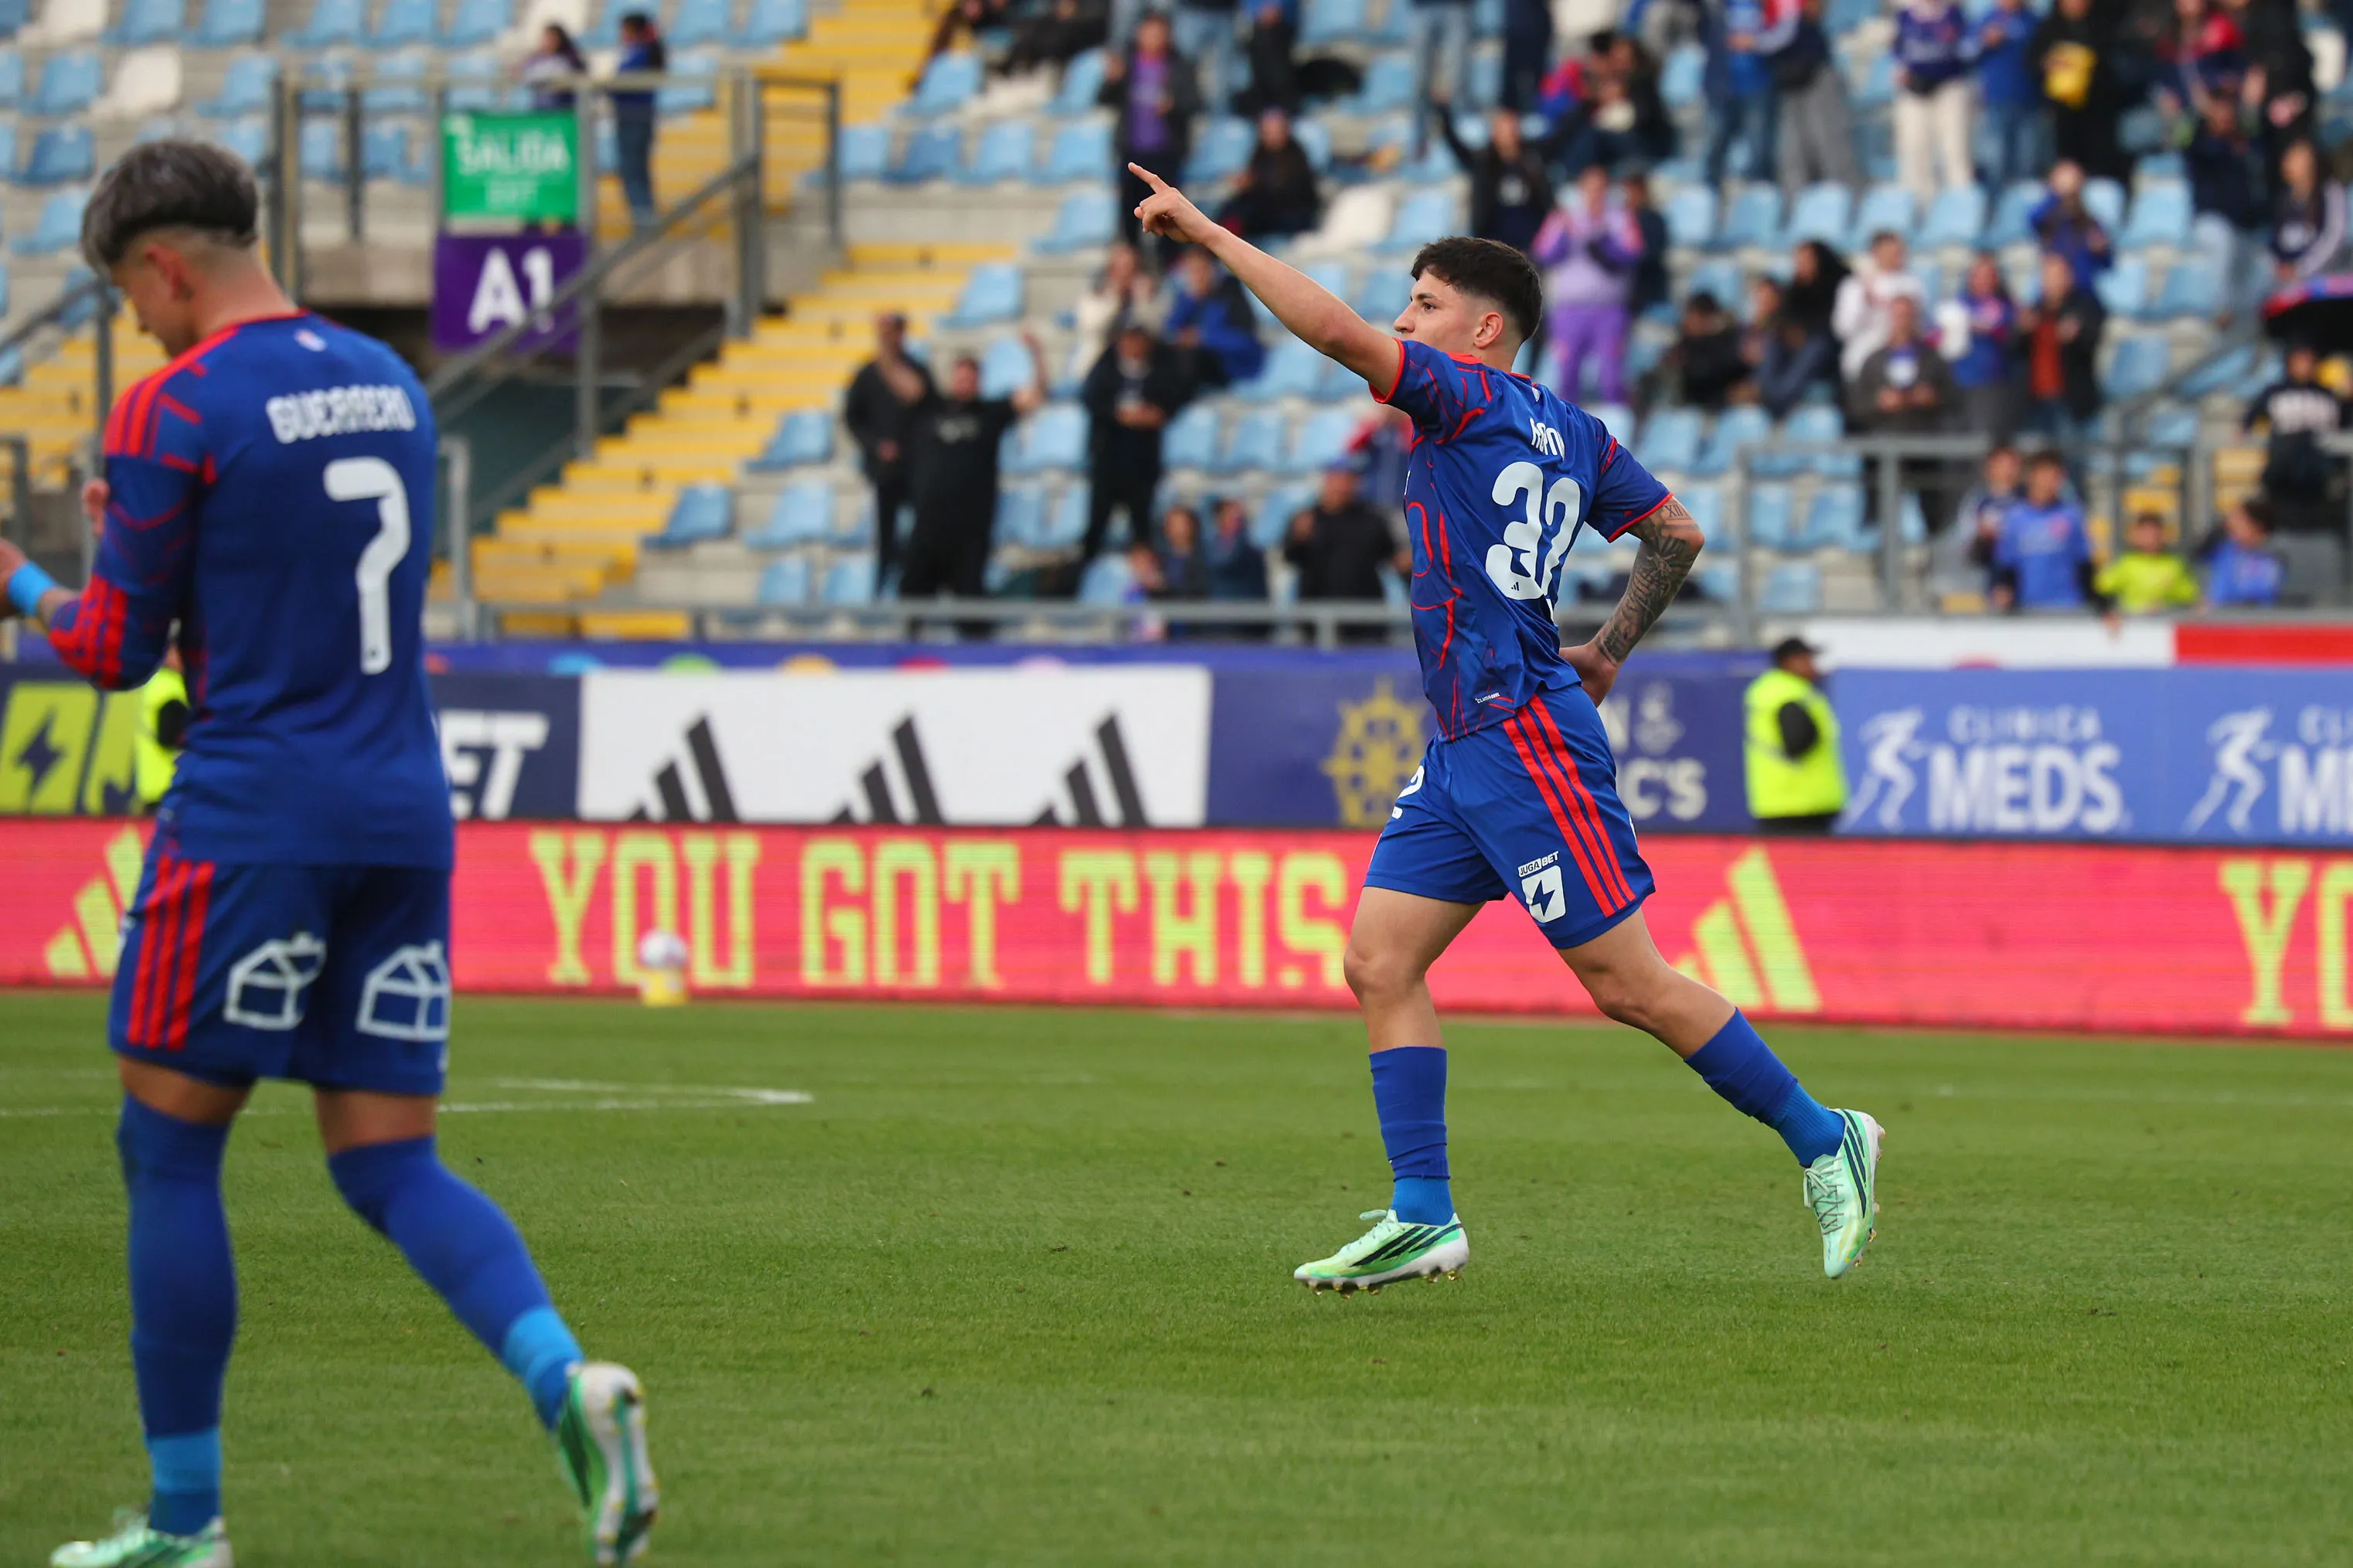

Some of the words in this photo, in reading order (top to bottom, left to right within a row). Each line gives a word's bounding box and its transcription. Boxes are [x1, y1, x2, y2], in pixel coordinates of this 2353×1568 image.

[468, 246, 554, 334] A1
[323, 456, 410, 675] 7
[1485, 461, 1581, 623] 32
[1929, 743, 2123, 832] MEDS
[530, 832, 759, 986] YOU
[802, 836, 1020, 989] GOT
